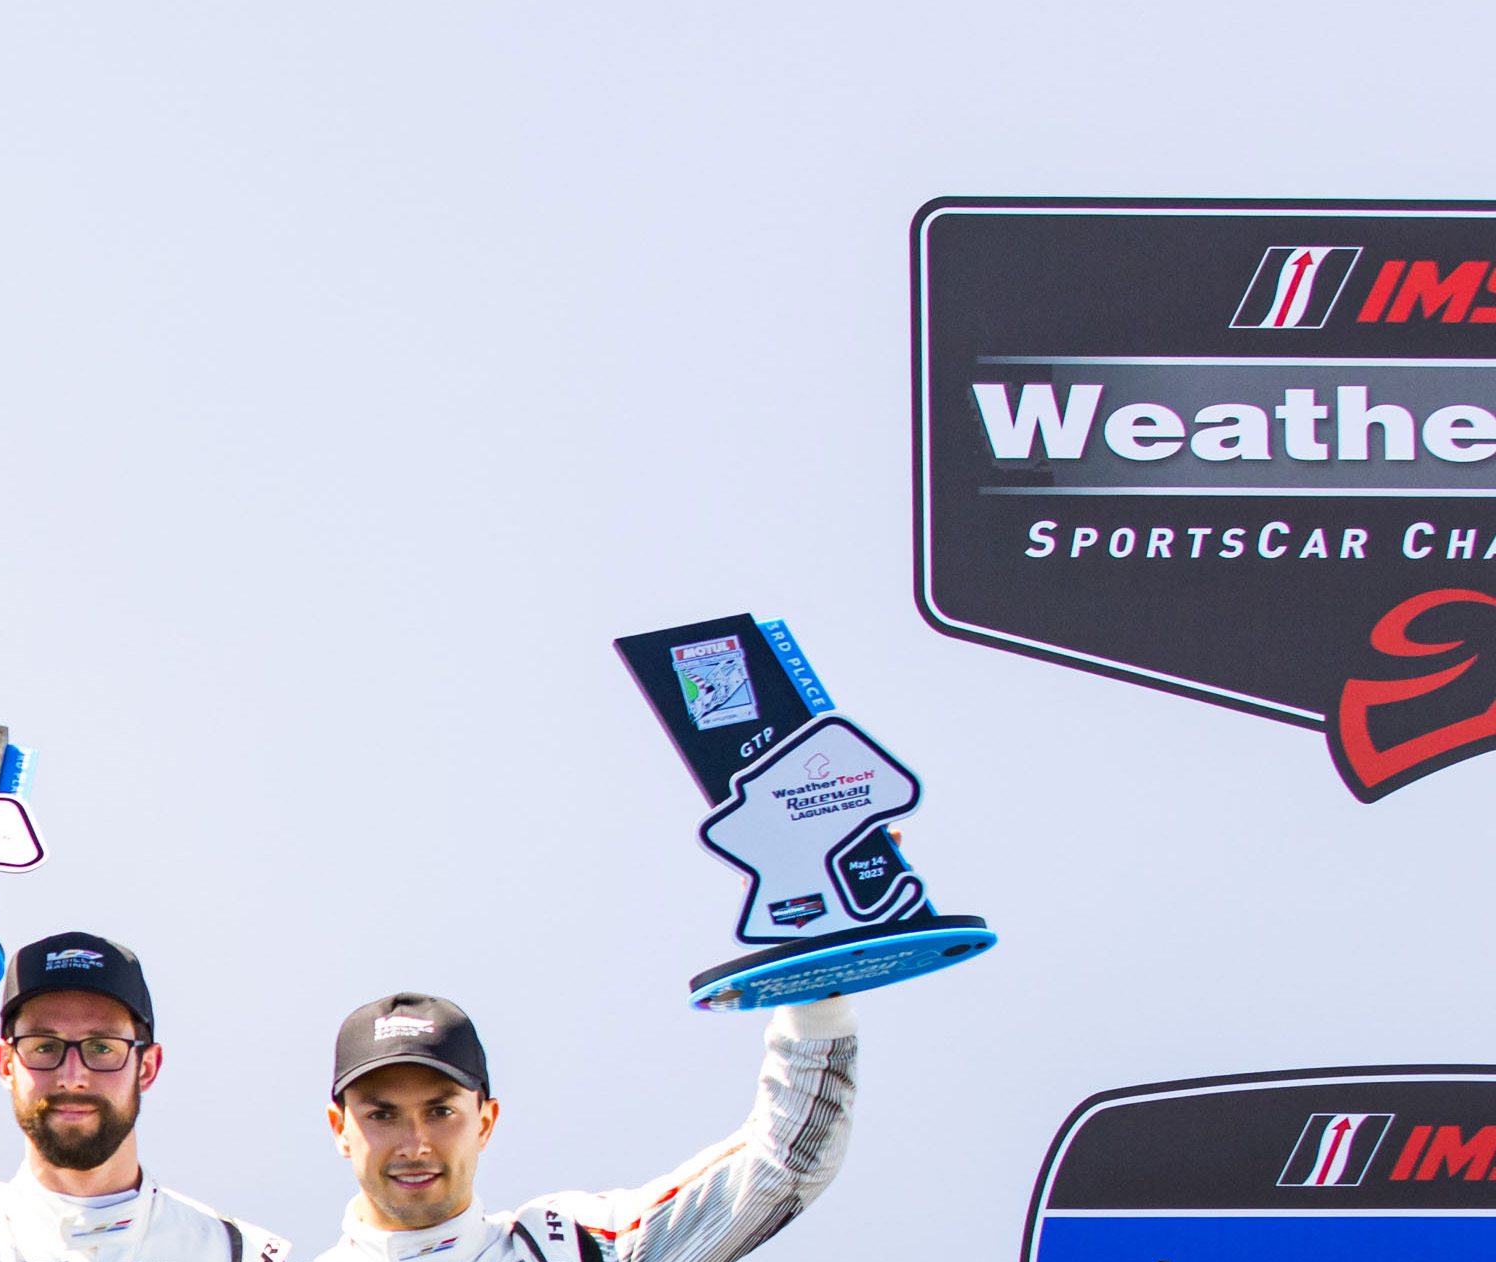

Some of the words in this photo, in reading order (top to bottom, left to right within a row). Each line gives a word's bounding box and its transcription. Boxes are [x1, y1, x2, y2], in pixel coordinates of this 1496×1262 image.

[682, 642, 730, 659] MOTUL
[767, 622, 792, 652] 3RD
[787, 657, 826, 707] PLACE
[739, 726, 775, 758] GTP
[772, 770, 875, 799] WeatherTech
[786, 784, 872, 810] Raceway
[790, 805, 839, 821] LAGUNA
[841, 798, 872, 810] SECA
[849, 859, 869, 871] May
[858, 866, 885, 880] 2023
